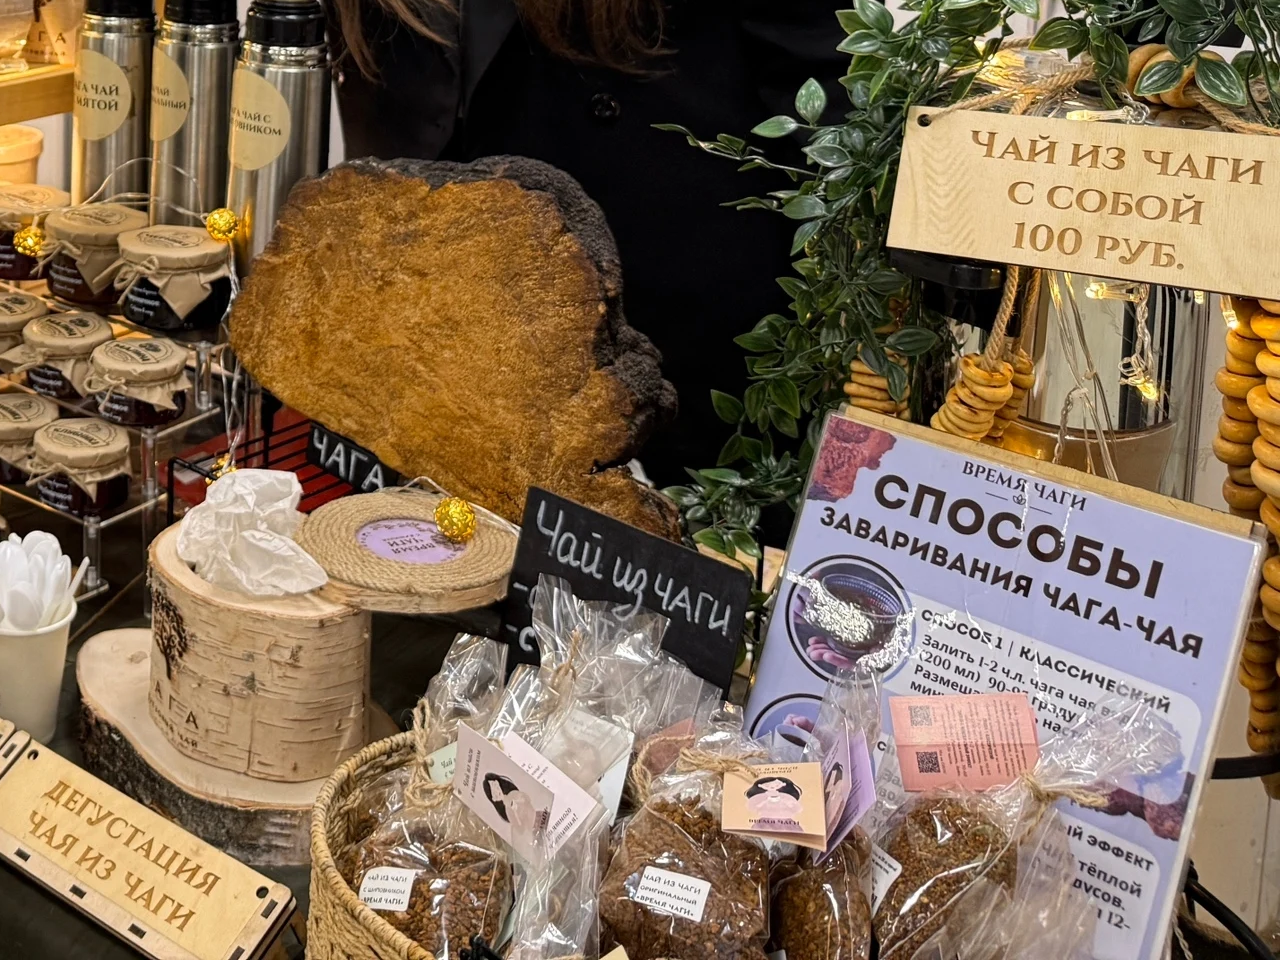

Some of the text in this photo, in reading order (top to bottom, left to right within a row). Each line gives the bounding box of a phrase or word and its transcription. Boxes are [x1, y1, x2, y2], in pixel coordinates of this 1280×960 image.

[91, 84, 119, 96] ЧАЙ
[242, 111, 261, 122] ЧАЙ
[970, 129, 1266, 186] ЧАЙ ИЗ ЧАГИ
[1007, 180, 1204, 226] С СОБОЙ
[1012, 221, 1185, 271] 100 РУБ.
[313, 428, 386, 492] ЧАГА
[962, 461, 1088, 511] ВРЕМЯ ЧАГИ
[874, 474, 1164, 599] СПОСОБЫ
[536, 499, 604, 580] Чай
[611, 556, 648, 622] из
[654, 572, 732, 637] ЧАГИ
[820, 506, 1204, 659] ЗАВАРИВАНИЯ ЧАГА-ЧАЯ
[922, 634, 976, 664] Залить
[1030, 677, 1065, 700] чага
[954, 665, 981, 683] мл)
[1019, 646, 1171, 714] КЛАССИЧЕСКИЙ
[41, 778, 223, 898] ДЕГУСТАЦИЯ
[1086, 834, 1155, 872] ЭФФЕКТ
[27, 810, 196, 933] ЧАЯ ИЗ ЧАГИ
[640, 884, 697, 906] ОРИГИНАЛЬНЫЙ
[643, 874, 702, 895] ЧАЙ ИЗ ЧАГИ
[1073, 878, 1126, 911] дусов.
[1078, 860, 1142, 899] тёплой
